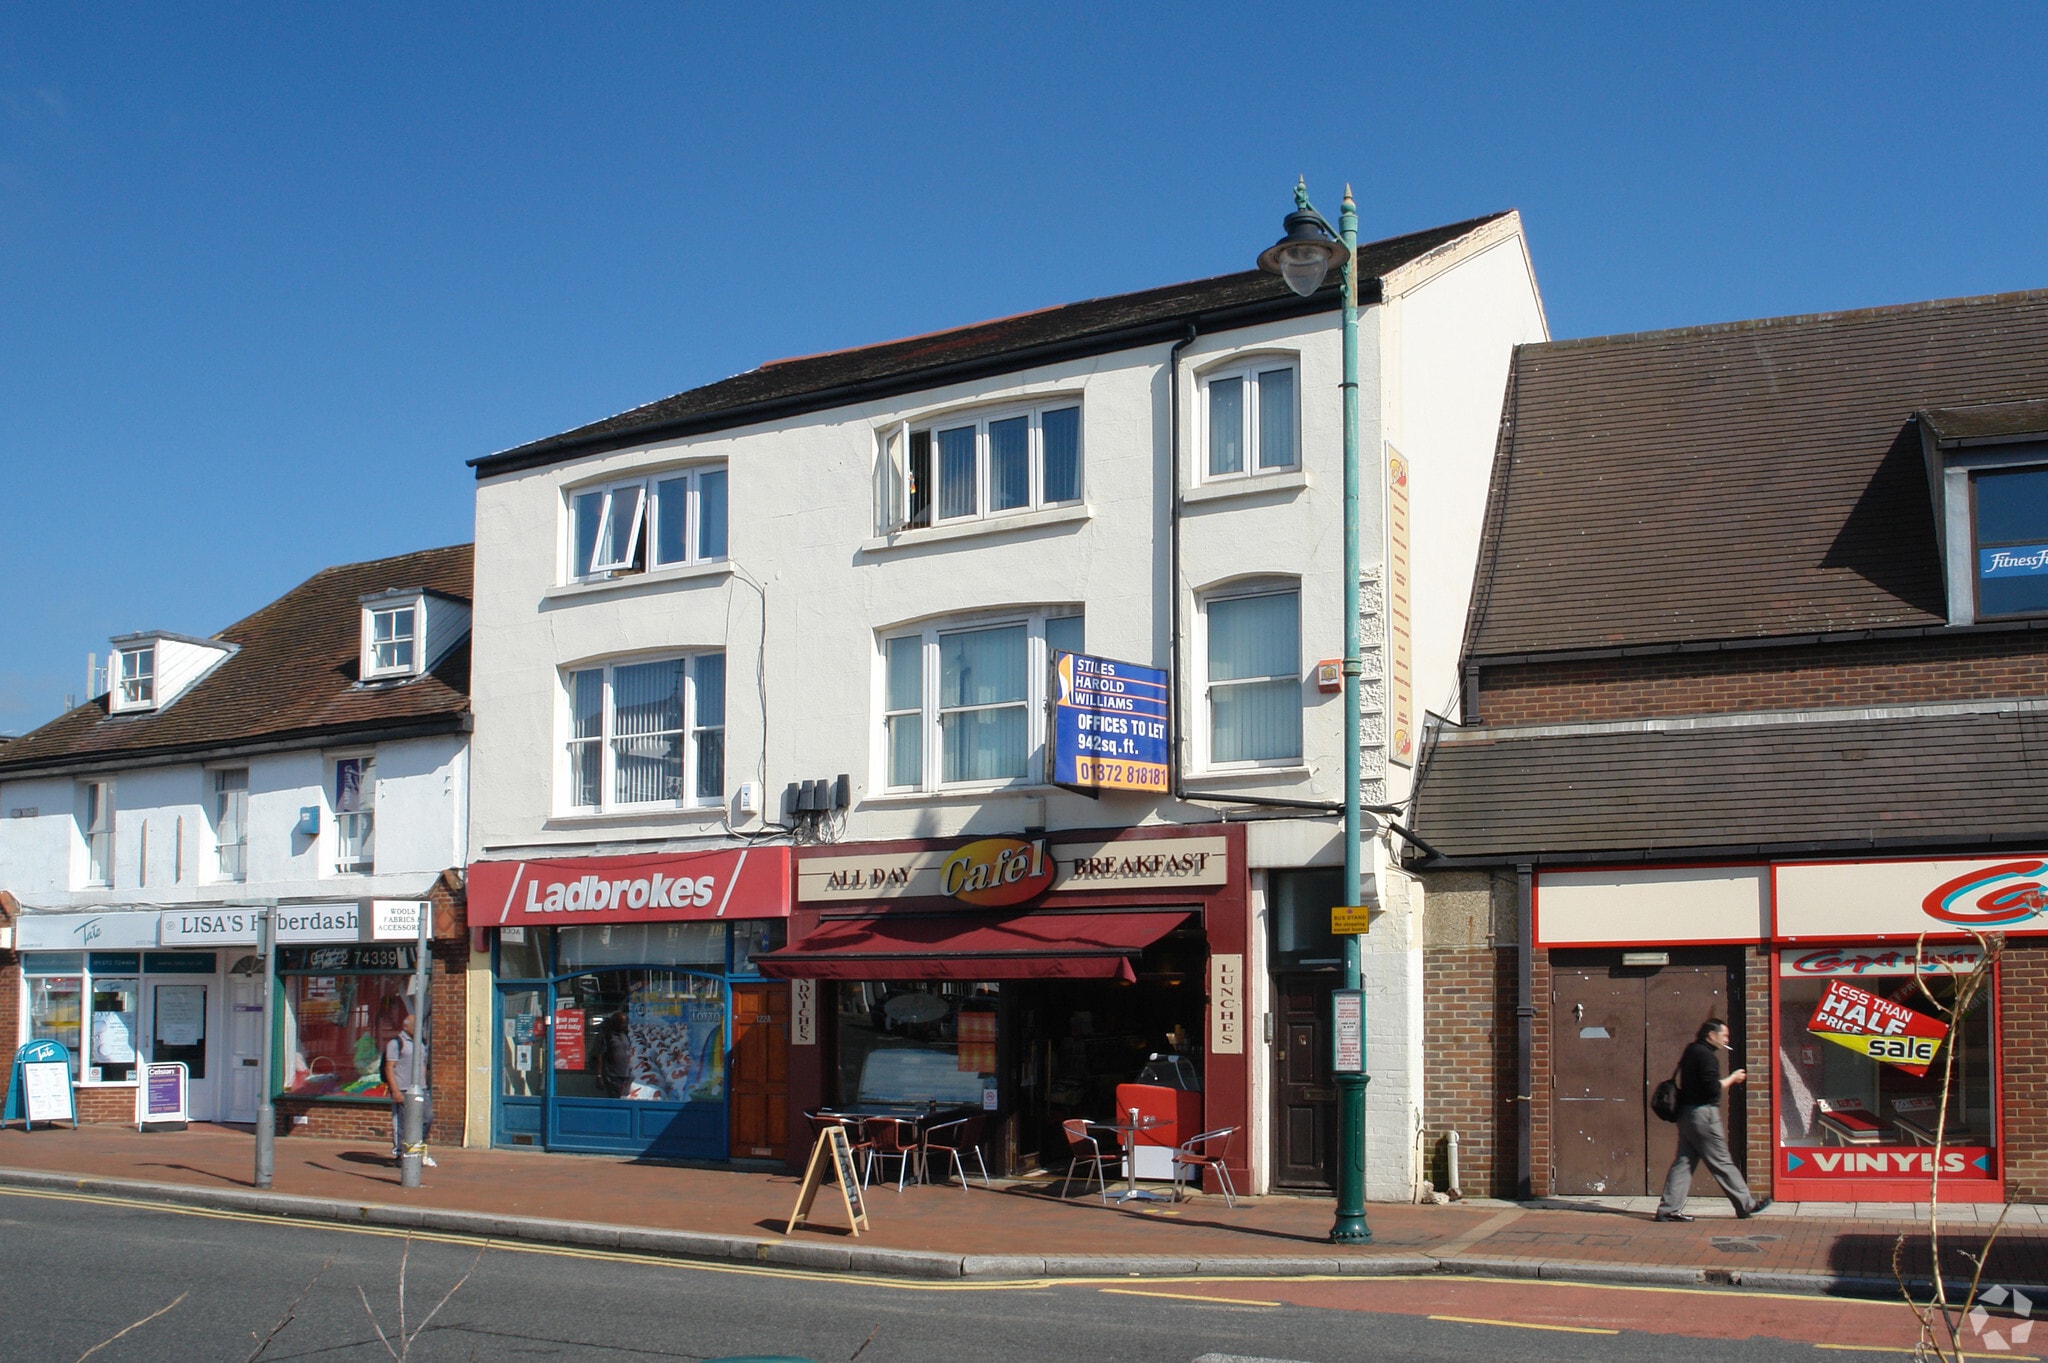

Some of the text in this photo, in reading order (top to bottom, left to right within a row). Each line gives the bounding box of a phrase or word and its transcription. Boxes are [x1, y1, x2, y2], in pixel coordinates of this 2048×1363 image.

[1077, 659, 1115, 676] STILES
[1075, 676, 1125, 693] HAROLD
[1075, 692, 1133, 710] WILLIAMS
[1078, 713, 1165, 740] OFFICES TO LET
[1081, 762, 1166, 786] 01372 818181
[831, 865, 912, 886] ALL DAY
[1073, 852, 1210, 876] BREAKFAST
[524, 872, 715, 913] Ladbrokes
[73, 917, 103, 946] Tate
[181, 911, 358, 934] LISA'S Hberdash
[1219, 963, 1235, 1045] LUNCHES
[1830, 981, 1871, 1005] LESS
[1873, 998, 1913, 1023] THAN
[1816, 1011, 1863, 1034] PRICE
[1822, 993, 1907, 1036] HALF
[28, 1043, 56, 1062] Tate
[1867, 1035, 1933, 1060] sale
[1812, 1153, 1965, 1172] VINYLS
